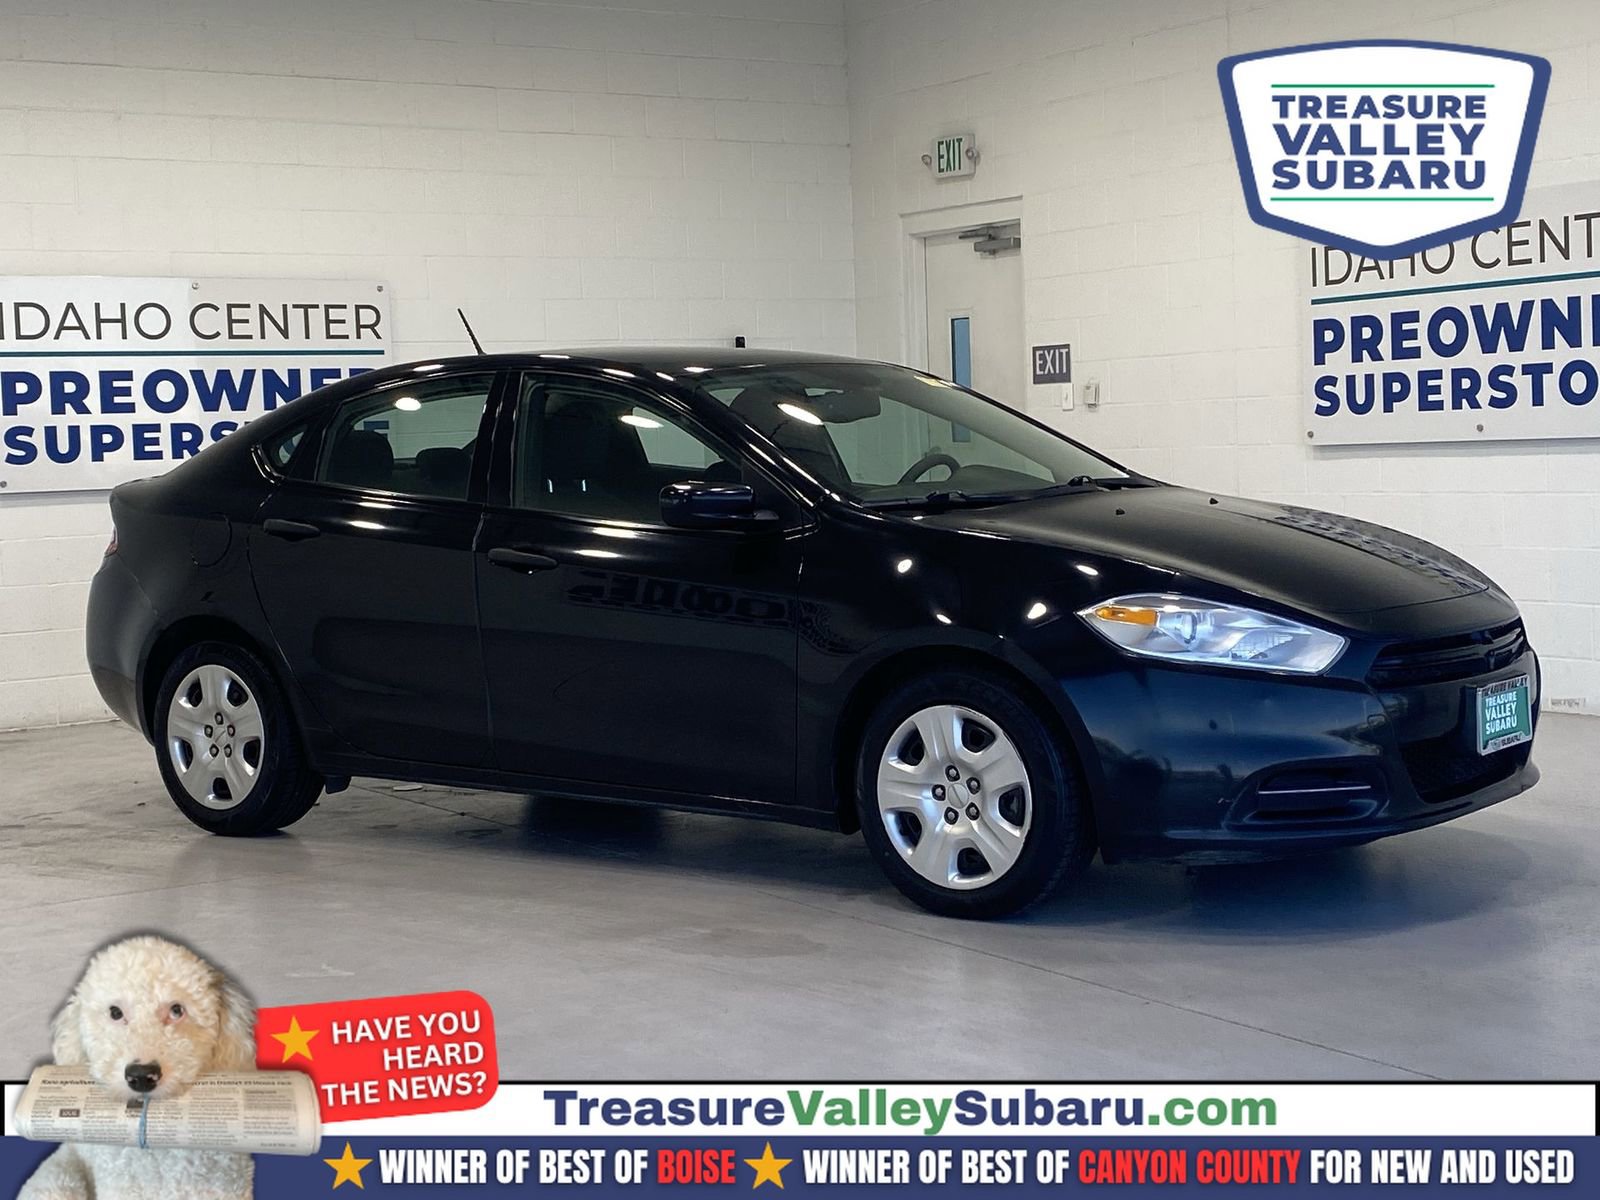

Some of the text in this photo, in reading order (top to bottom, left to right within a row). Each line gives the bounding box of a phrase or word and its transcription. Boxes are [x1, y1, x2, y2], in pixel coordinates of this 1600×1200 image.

[937, 137, 963, 173] EXIT
[1471, 211, 1600, 269] CENT
[0, 302, 383, 341] IDAHO CENTER
[1035, 348, 1069, 375] EXIT
[1, 367, 376, 416] PREOWN
[1313, 359, 1600, 418] SUPERSTO
[1485, 691, 1517, 707] TREASURE
[1485, 702, 1517, 721] VALLEY
[1486, 715, 1518, 735] SUBARU
